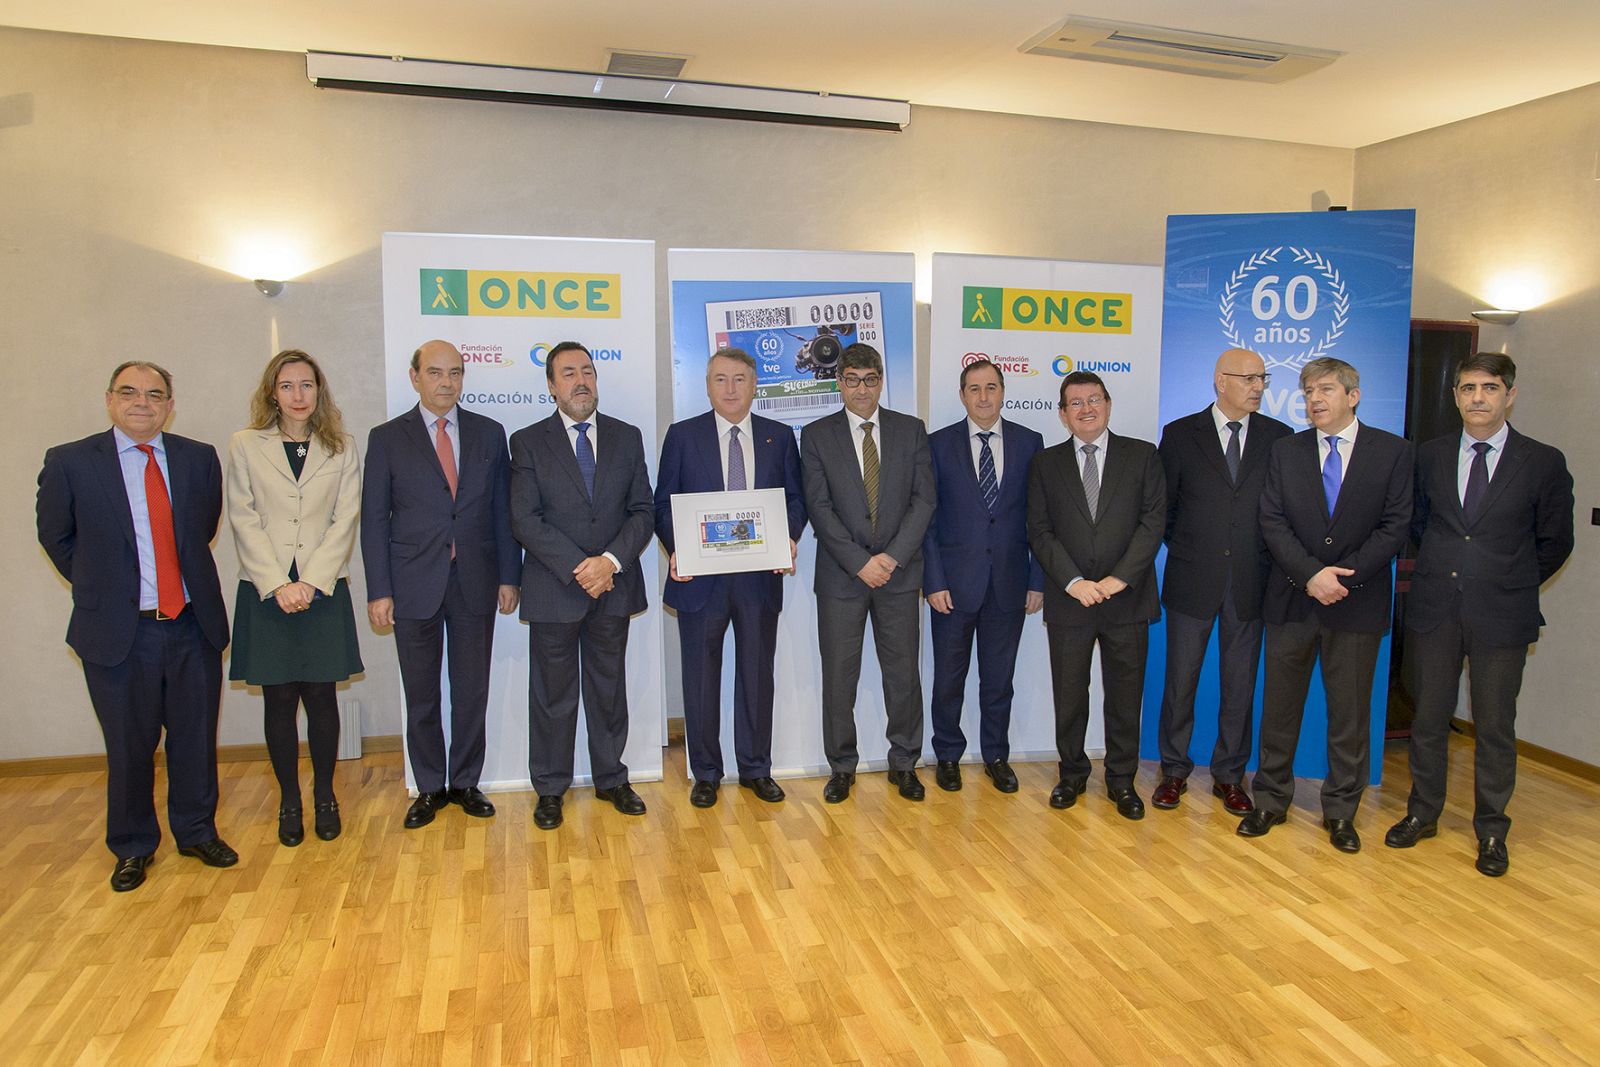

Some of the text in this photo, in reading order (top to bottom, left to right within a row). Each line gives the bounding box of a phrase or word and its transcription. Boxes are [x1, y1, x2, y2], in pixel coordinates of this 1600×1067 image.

[479, 277, 610, 311] ONCE
[1251, 275, 1318, 321] 60
[810, 302, 873, 324] 00000
[1012, 295, 1123, 327] ONCE
[859, 322, 875, 330] SERIE
[860, 331, 876, 341] 000
[1254, 322, 1311, 344] años
[762, 338, 777, 350] 60
[994, 355, 1029, 363] Fundación
[763, 363, 781, 374] tve
[1077, 360, 1131, 373] ILUNION
[1001, 398, 1052, 410] CACIÓN
[1259, 388, 1312, 425] ve
